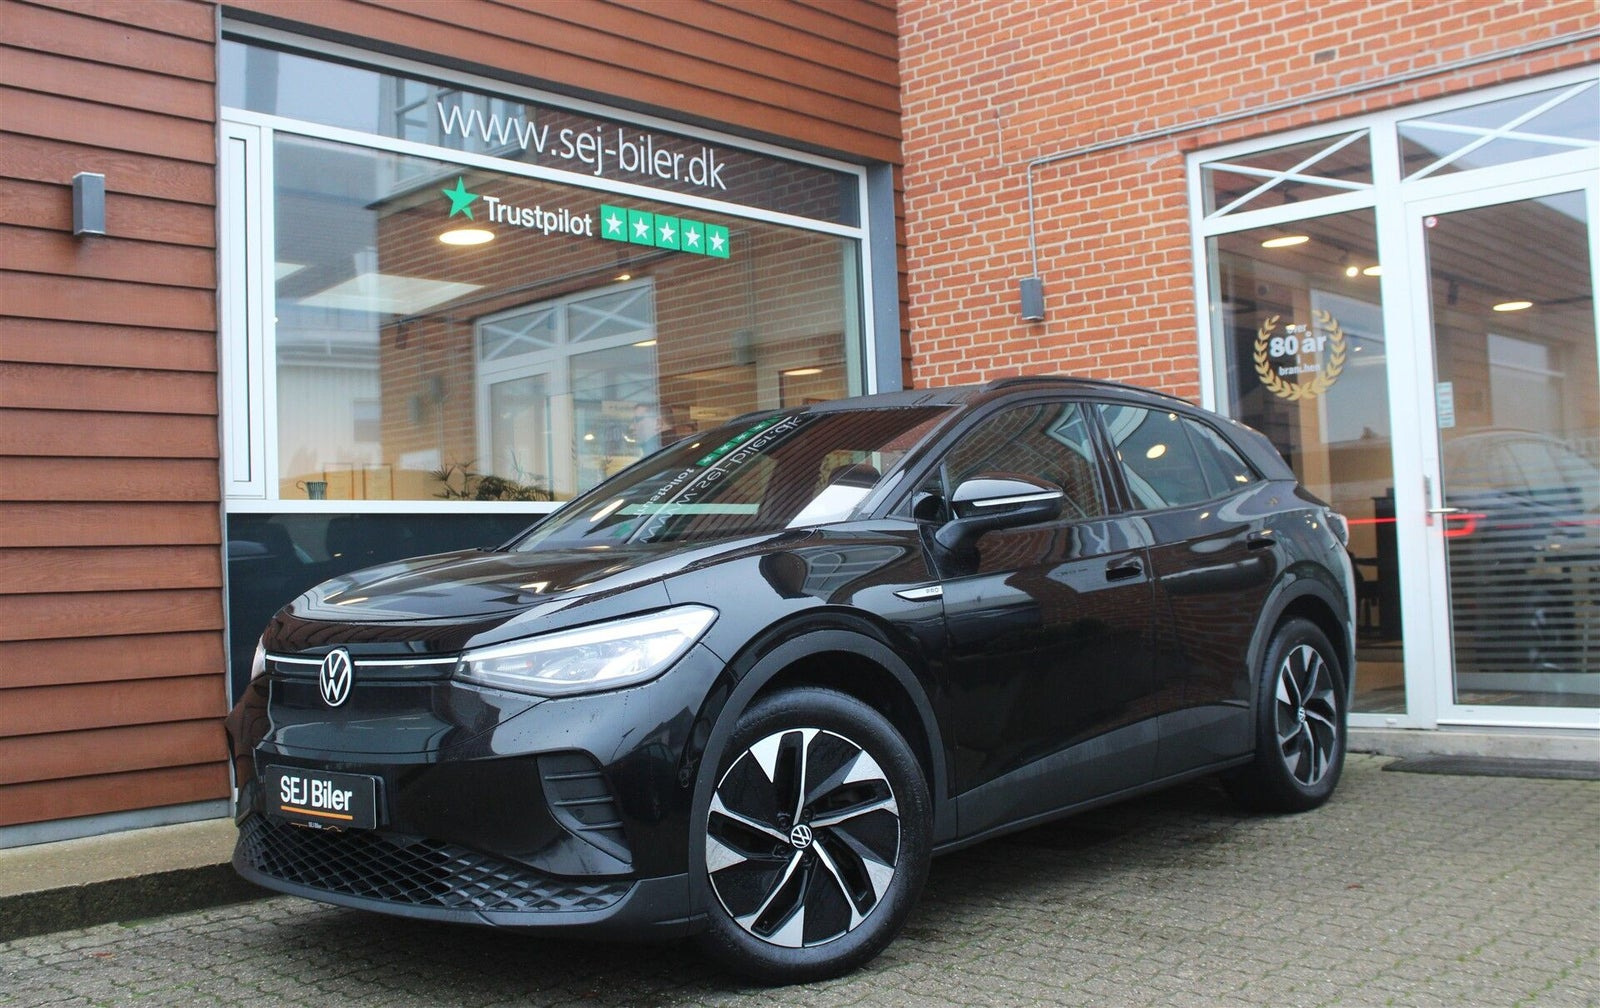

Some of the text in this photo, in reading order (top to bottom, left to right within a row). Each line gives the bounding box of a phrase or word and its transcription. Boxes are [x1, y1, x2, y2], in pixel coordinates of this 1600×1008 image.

[437, 102, 726, 190] www.sej-biler.dk
[483, 195, 593, 237] Trustpilot
[1270, 331, 1327, 357] 80 år
[280, 775, 353, 811] SEJ Biler
